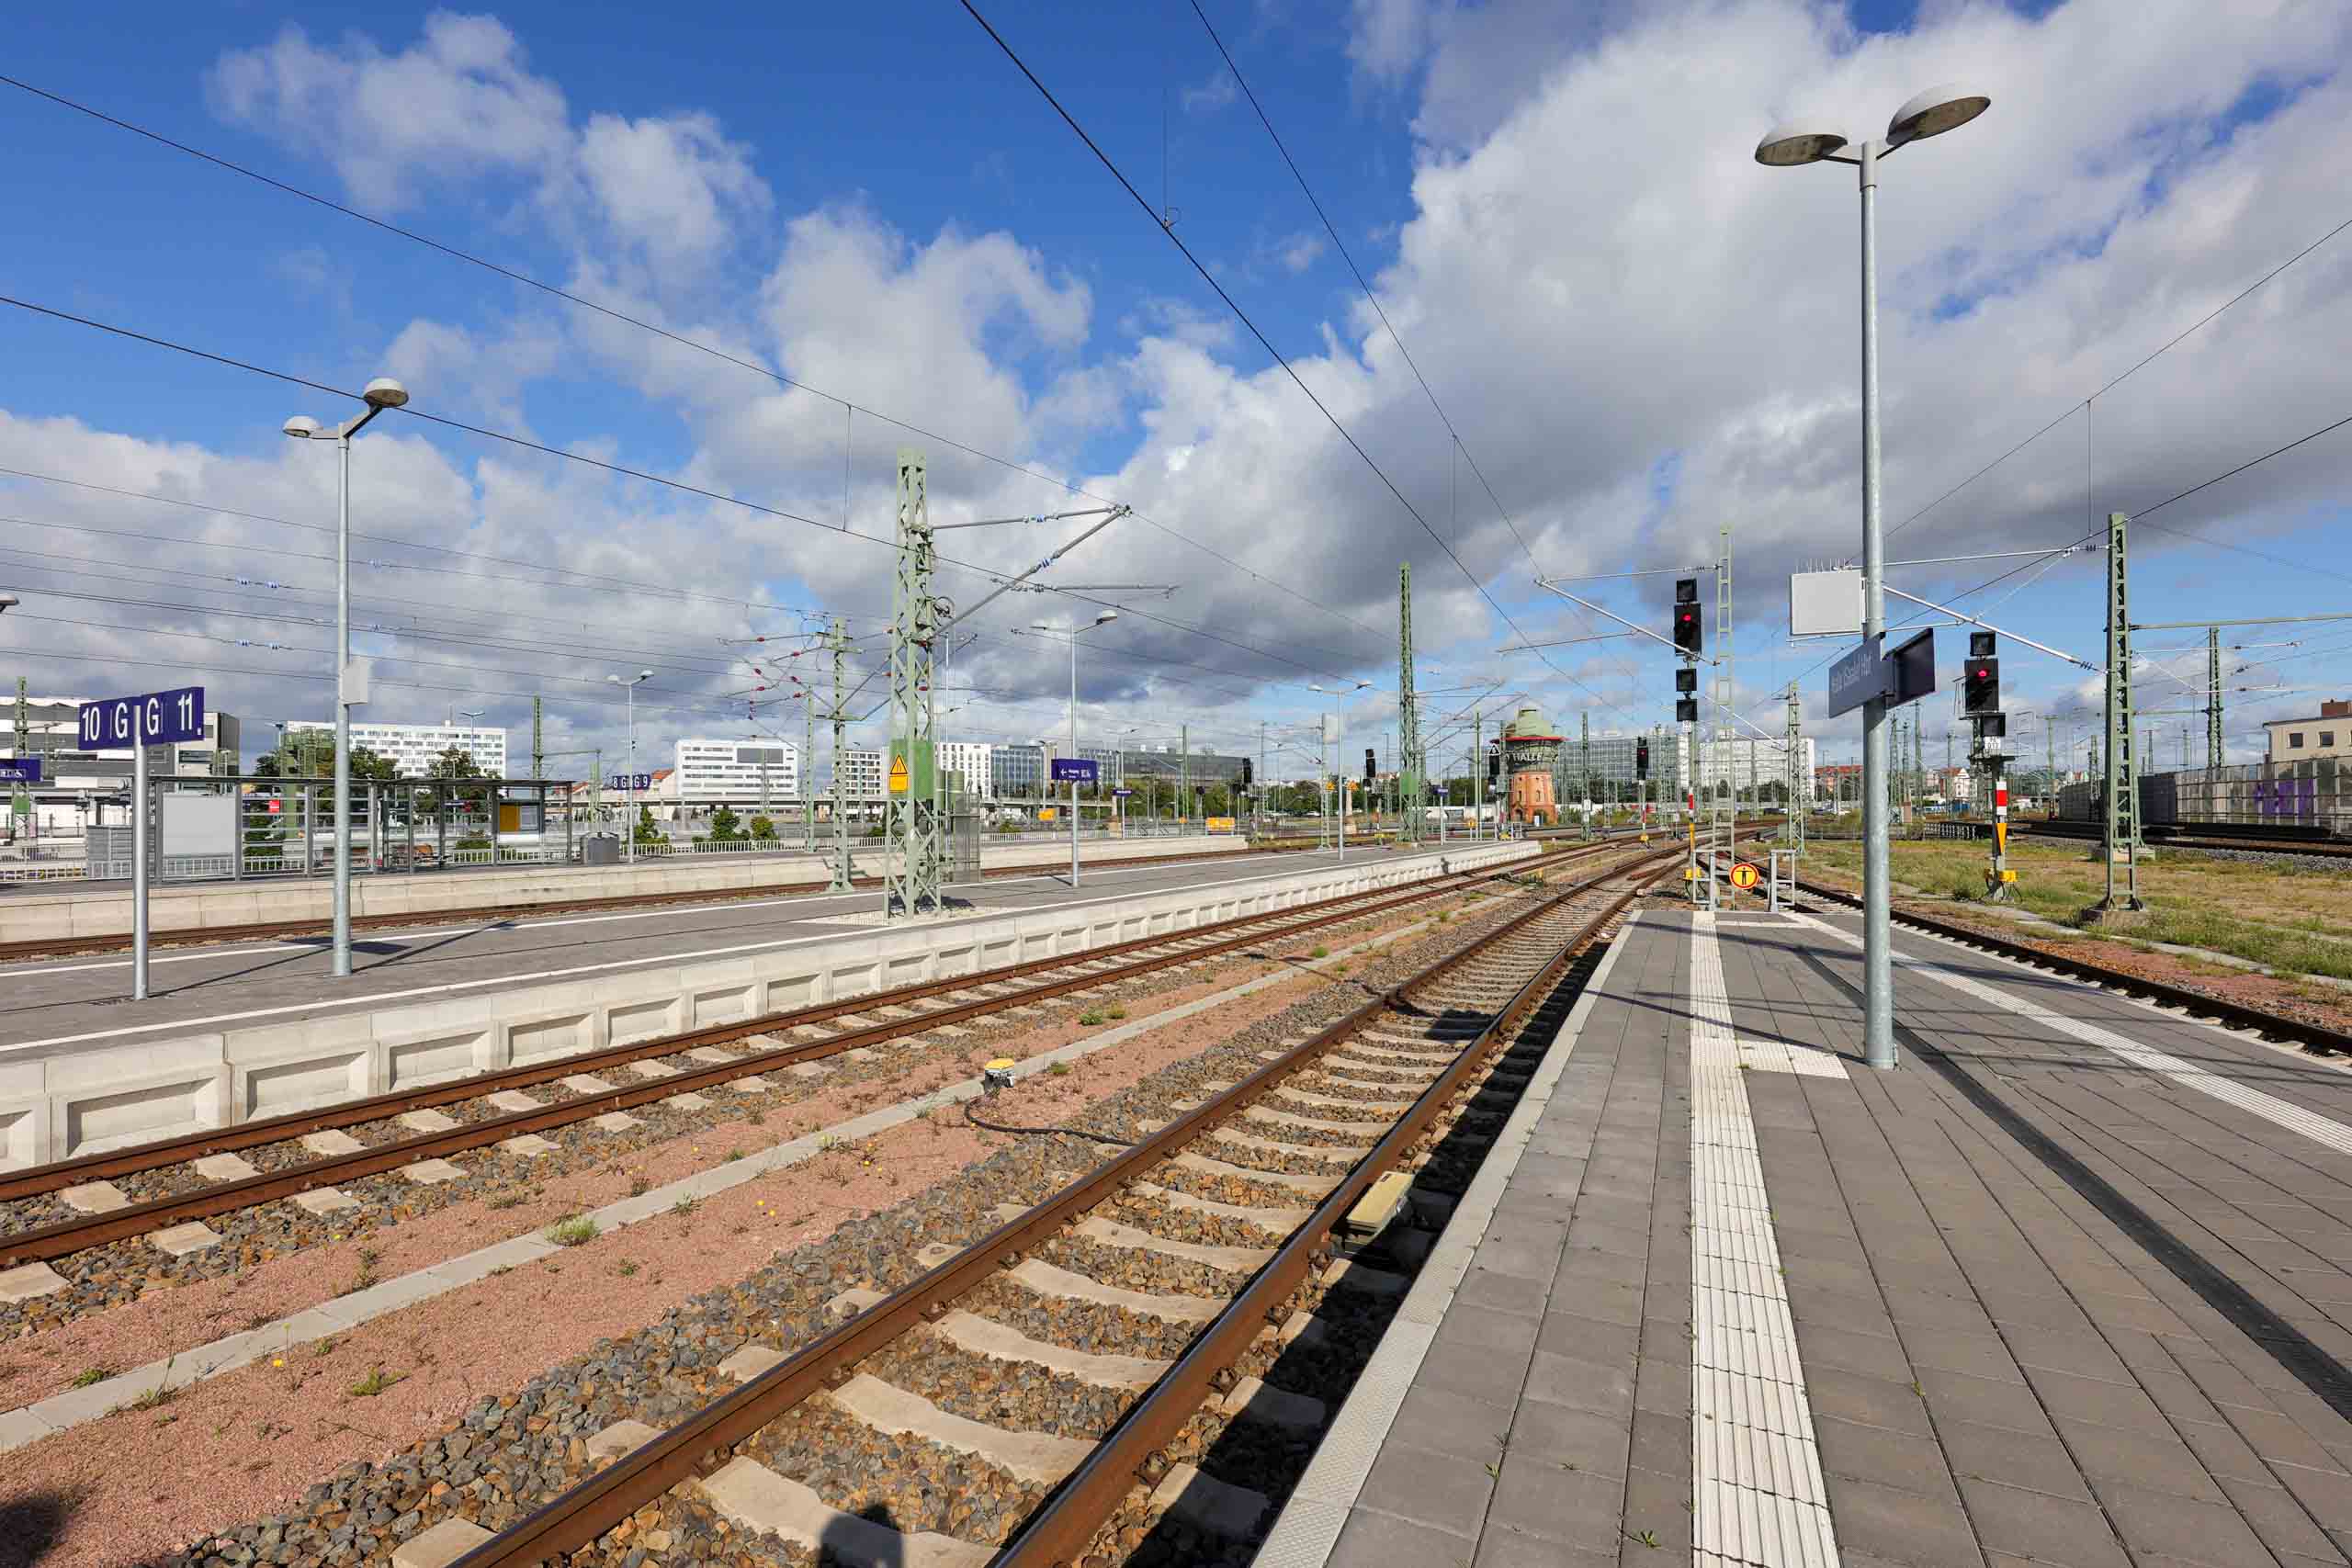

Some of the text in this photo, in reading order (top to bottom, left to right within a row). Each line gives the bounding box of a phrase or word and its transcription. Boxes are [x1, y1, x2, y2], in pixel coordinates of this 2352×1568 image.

[82, 693, 193, 741] 10 G G 11
[1512, 751, 1544, 761] HALLE
[613, 776, 618, 788] 8
[621, 776, 627, 788] G
[643, 775, 648, 787] 9
